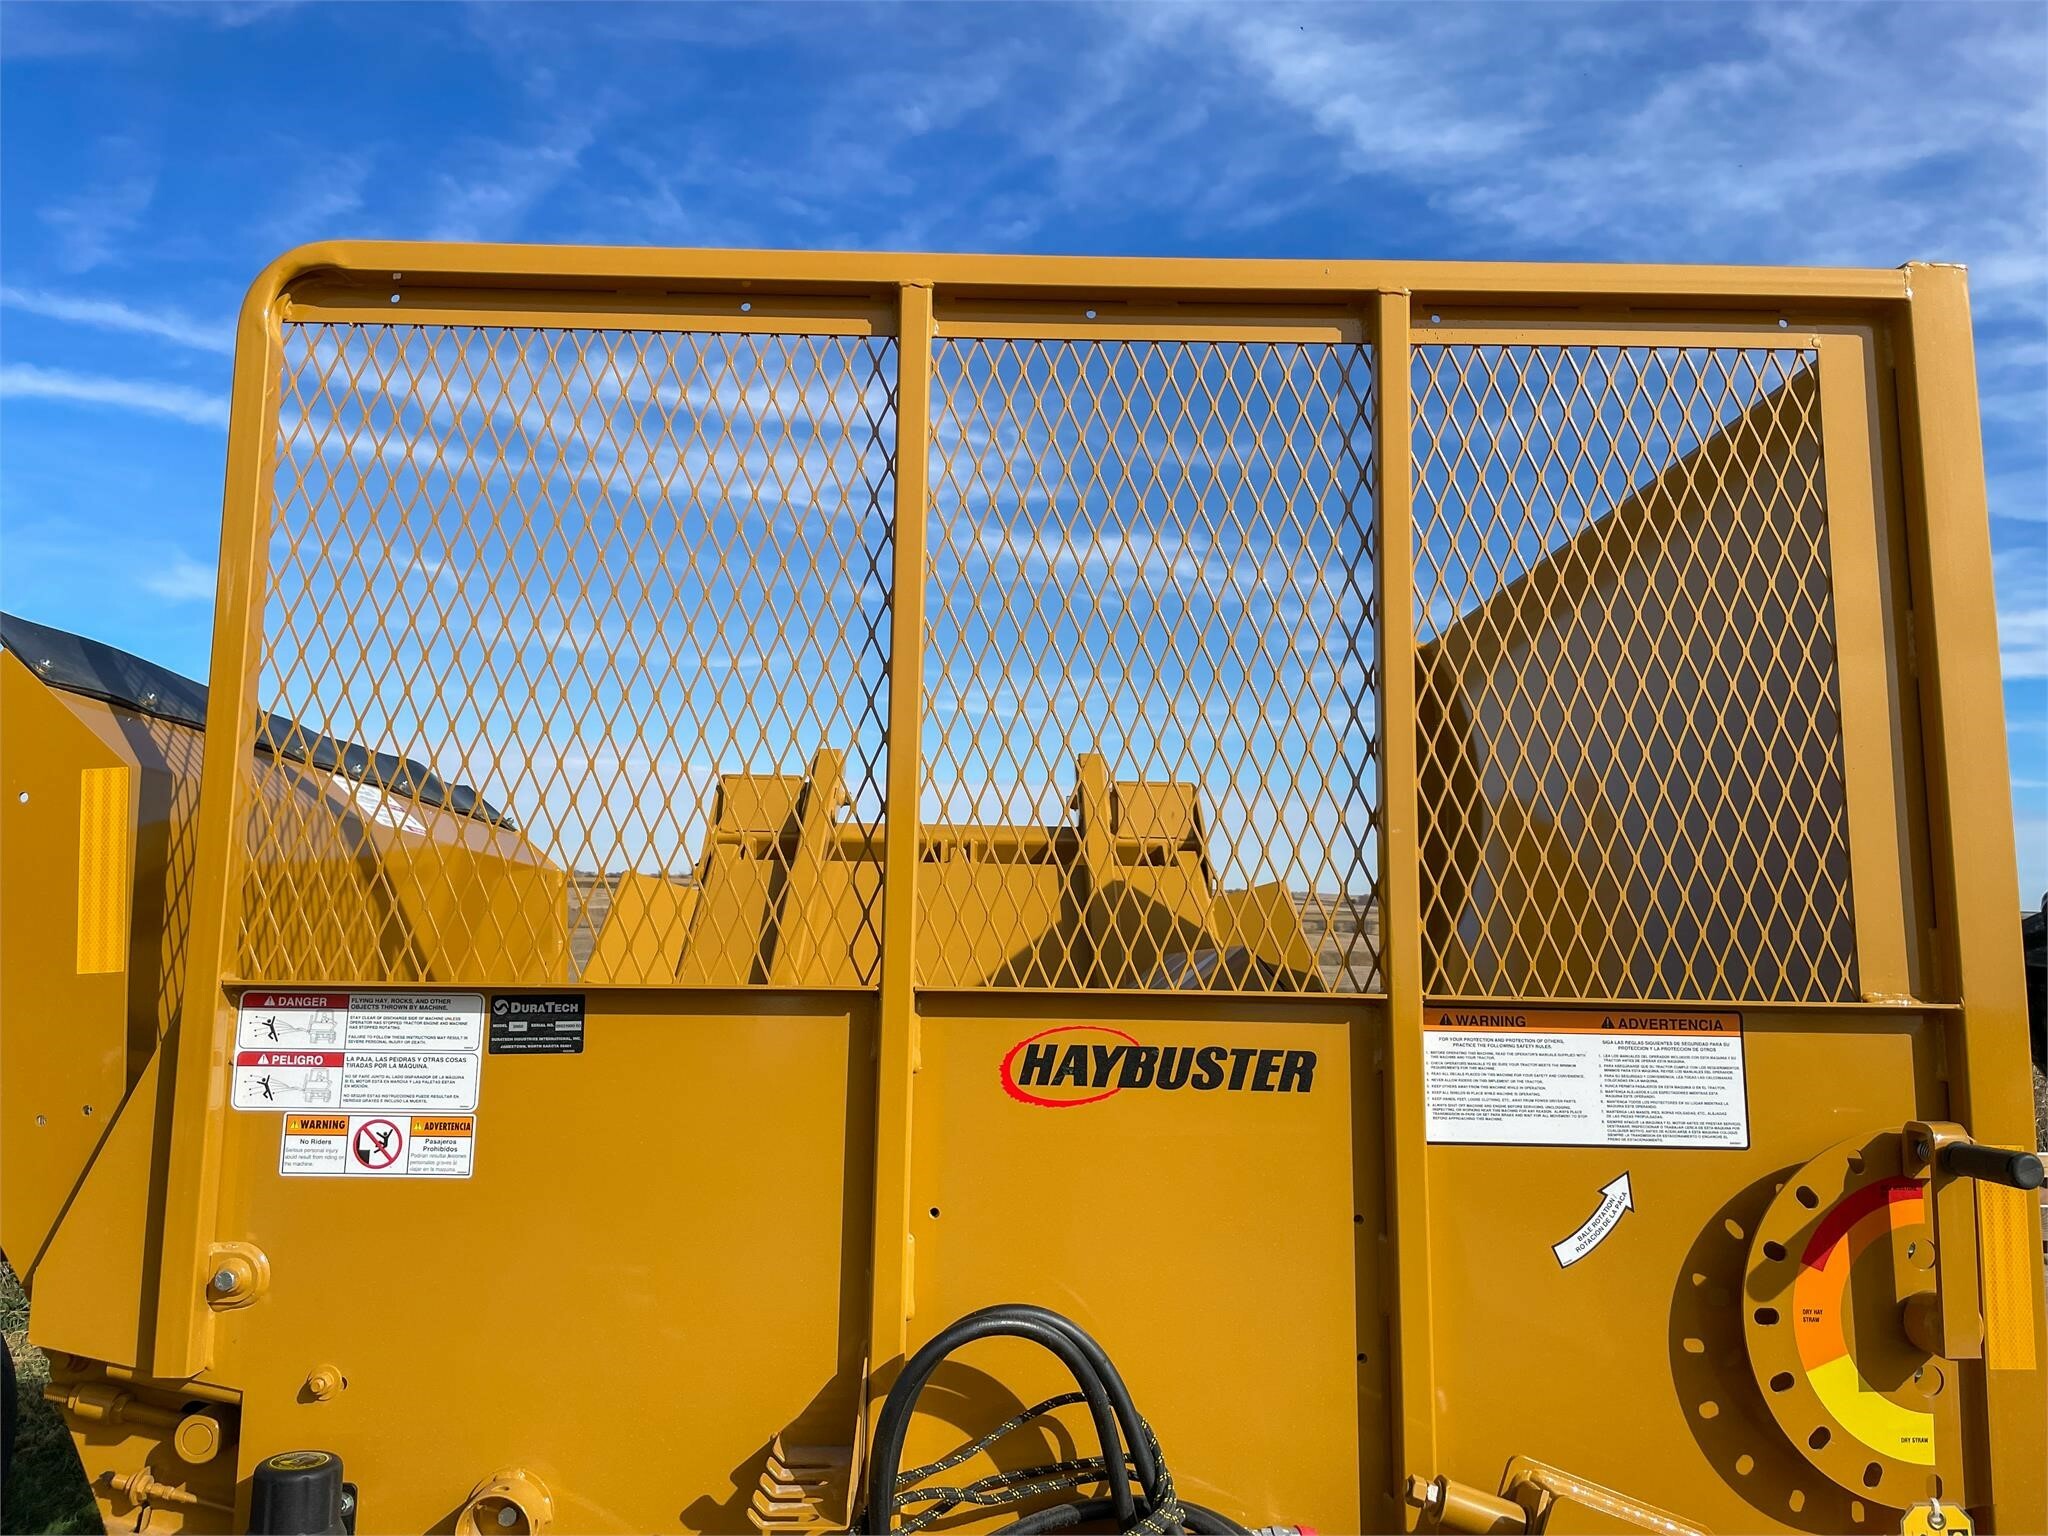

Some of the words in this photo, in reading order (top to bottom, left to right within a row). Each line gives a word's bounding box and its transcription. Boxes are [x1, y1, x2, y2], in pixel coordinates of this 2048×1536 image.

[278, 998, 327, 1006] DANGER
[1456, 1015, 1526, 1027] WARNING
[1618, 1018, 1723, 1031] ADVERTENCIA
[272, 1055, 323, 1065] PELIGRO
[1018, 1044, 1317, 1093] HAYBUSTER
[300, 1120, 345, 1129] WARNING
[424, 1121, 471, 1131] ADVERTENCIA
[1575, 1227, 1604, 1253] ROTACION
[1603, 1218, 1612, 1228] DE
[1609, 1209, 1617, 1218] LA
[1615, 1192, 1627, 1210] PACA
[1577, 1226, 1593, 1241] BALE
[1592, 1198, 1615, 1228] ROTATION
